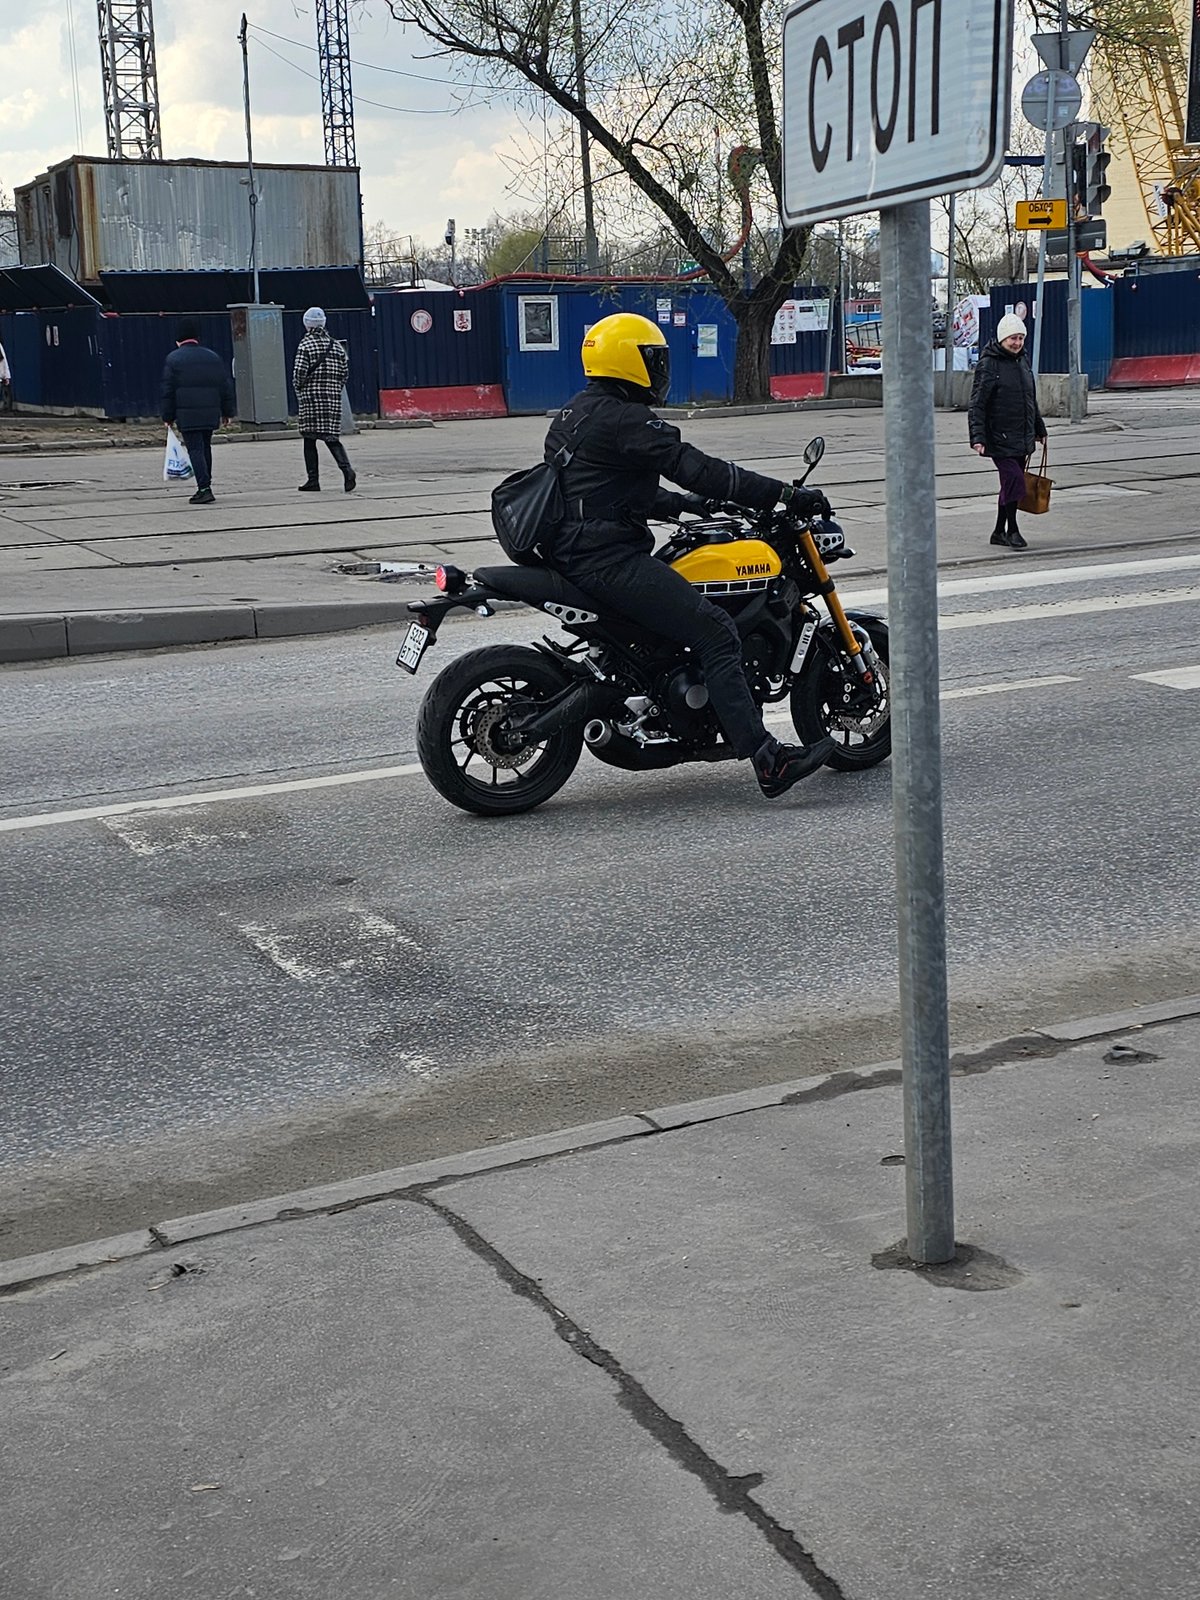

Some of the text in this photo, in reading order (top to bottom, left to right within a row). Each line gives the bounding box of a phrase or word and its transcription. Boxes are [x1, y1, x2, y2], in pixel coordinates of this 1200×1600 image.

[808, 0, 942, 173] СТОП
[1028, 202, 1054, 213] ОБХОД
[735, 563, 771, 576] YAMAHA
